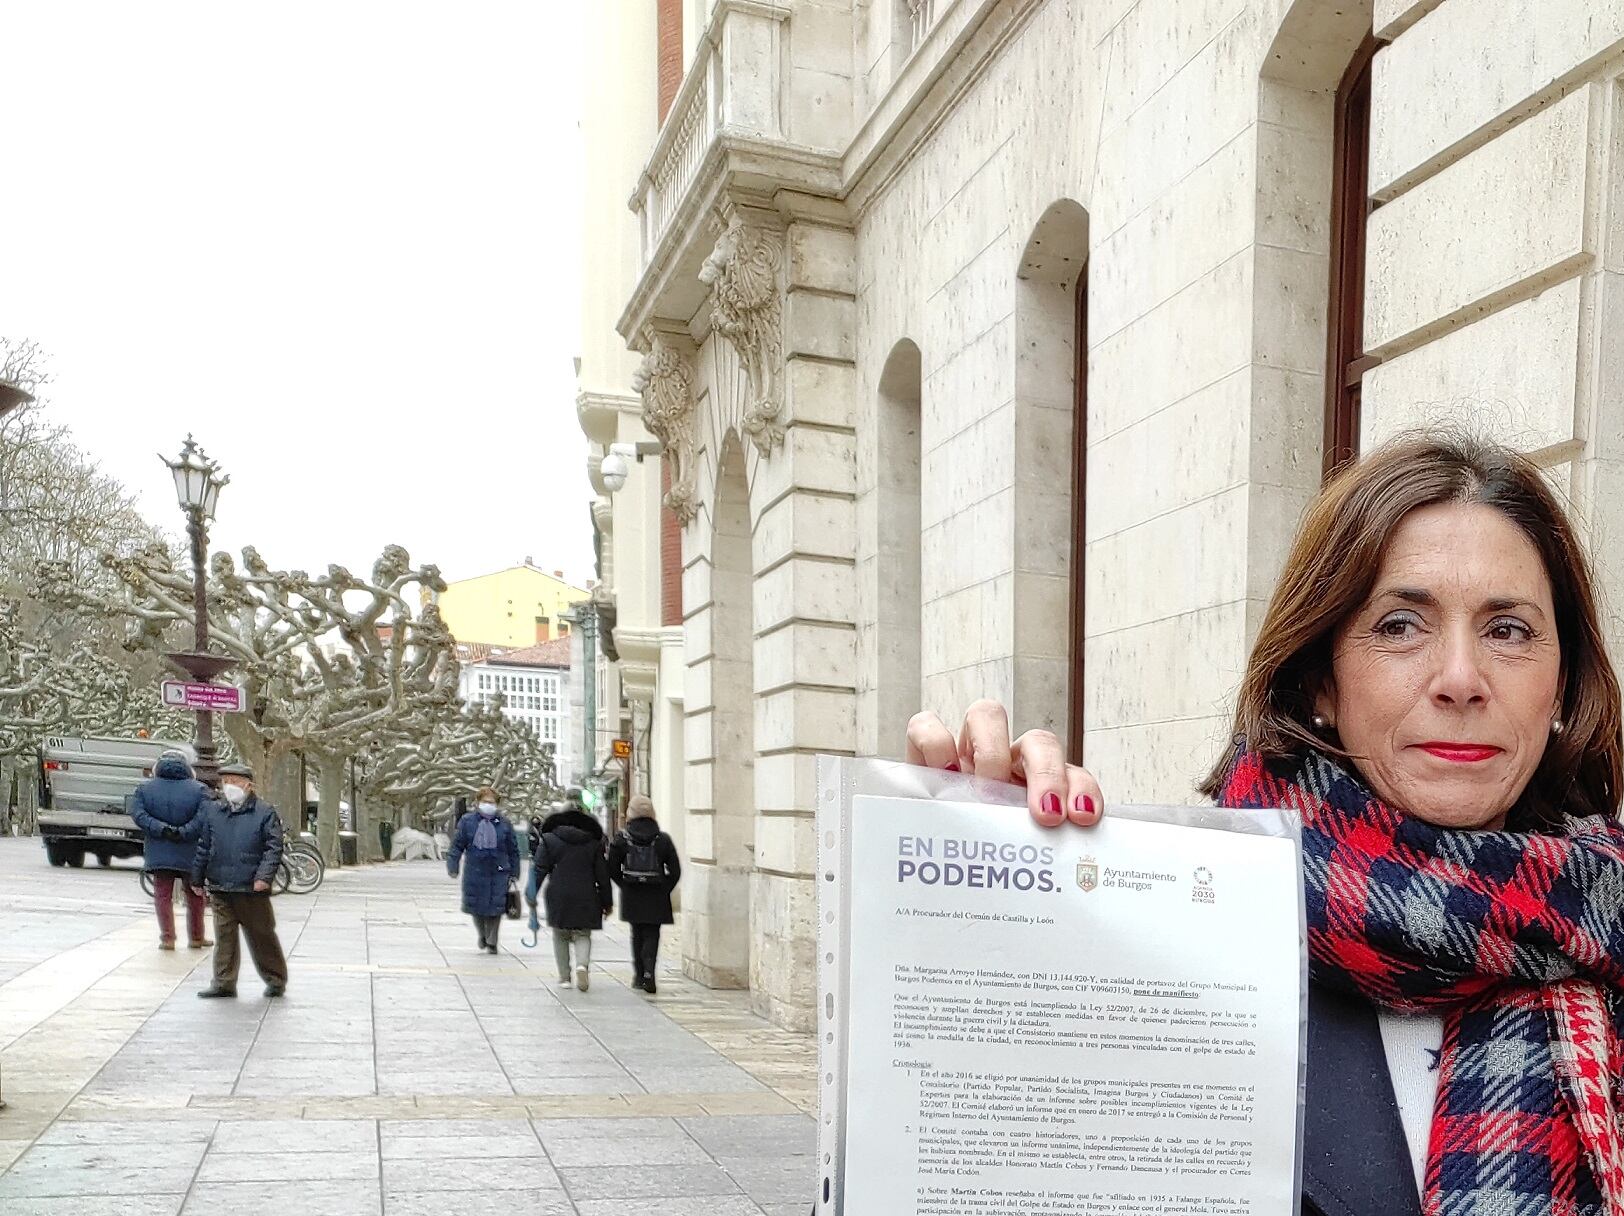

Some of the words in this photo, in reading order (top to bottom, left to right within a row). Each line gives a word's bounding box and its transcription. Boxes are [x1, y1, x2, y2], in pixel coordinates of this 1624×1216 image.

[898, 836, 935, 858] EN
[944, 838, 1054, 866] BURGOS
[898, 859, 1062, 893] PODEMOS.
[1104, 866, 1177, 882] Ayuntamiento
[1102, 878, 1116, 887] de
[1118, 879, 1152, 892] Burgos
[1192, 890, 1215, 898] 2030
[896, 907, 910, 916] A/A
[912, 908, 951, 918] Procurador
[952, 910, 964, 919] del
[964, 912, 990, 920] Común
[991, 912, 1001, 921] de
[1002, 914, 1028, 924] Castilla
[1036, 916, 1055, 925] León
[894, 973, 920, 984] Burgos
[1023, 981, 1032, 989] de
[1033, 982, 1060, 992] Burgos,
[1075, 984, 1087, 992] CIF
[949, 967, 975, 978] Arroyo
[976, 969, 1015, 980] Hernández,
[1032, 972, 1047, 980] DNI
[1136, 978, 1145, 986] de
[1146, 979, 1176, 988] portavoz
[1177, 980, 1188, 988] del
[1189, 981, 1211, 991] Grupo
[1213, 982, 1246, 993] Municipal
[1248, 984, 1258, 992] En
[986, 998, 1011, 1008] Burgos
[1013, 999, 1028, 1007] está
[1089, 1003, 1102, 1014] Ley
[1106, 1004, 1136, 1014] 52/2007,
[972, 1006, 1003, 1015] derechos
[1026, 1010, 1062, 1018] establecen
[1064, 1012, 1093, 1020] medidas
[1108, 1014, 1126, 1022] favor
[1141, 1016, 1167, 1025] quienes
[1170, 1017, 1207, 1027] padecieron
[986, 1017, 1002, 1025] civil
[968, 1025, 985, 1033] debe
[993, 1028, 1006, 1036] que
[1016, 1027, 1056, 1037] Consistorio
[1057, 1030, 1088, 1038] mantiene
[986, 1036, 1012, 1045] ciudad,
[1132, 1043, 1168, 1052] vinculadas
[1193, 1046, 1212, 1056] golpe
[956, 1071, 973, 1079] 2016
[1019, 1075, 1060, 1083] unanimidad
[1108, 1079, 1148, 1089] municipales
[1150, 1080, 1181, 1090] presentes
[995, 1083, 1023, 1093] Popular,
[1027, 1084, 1052, 1093] Partido
[1055, 1086, 1090, 1096] Socialista,
[988, 1103, 1014, 1111] elaboró
[1108, 1108, 1126, 1116] 2017
[1136, 1109, 1161, 1120] entregó
[1176, 1111, 1208, 1120] Comisión
[1219, 1113, 1248, 1121] Personal
[1137, 1155, 1163, 1163] retirada
[1214, 1148, 1238, 1158] partido
[1096, 1163, 1128, 1171] Fernando
[1180, 1166, 1217, 1176] procurador
[1163, 1204, 1188, 1214] general
[1204, 1196, 1236, 1206] Española,
